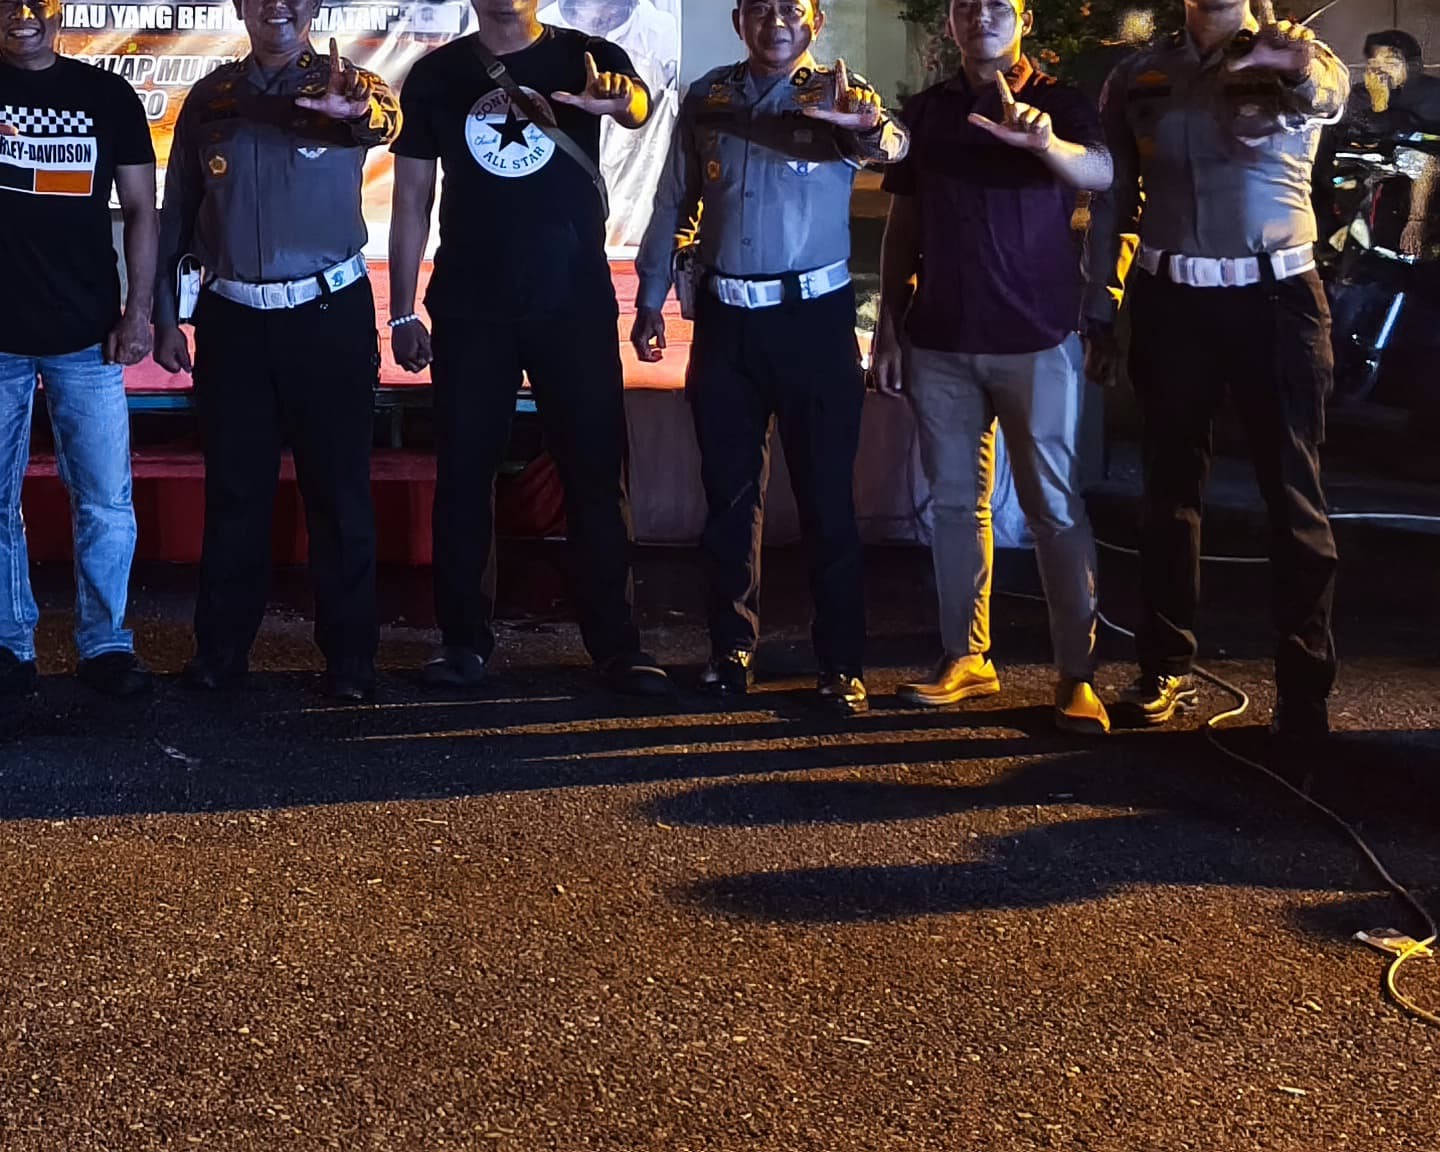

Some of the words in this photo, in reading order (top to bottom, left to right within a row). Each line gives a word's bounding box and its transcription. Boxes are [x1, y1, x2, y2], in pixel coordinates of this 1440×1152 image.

[112, 5, 172, 30] YANG
[483, 151, 507, 169] ALL
[512, 145, 546, 170] STAR
